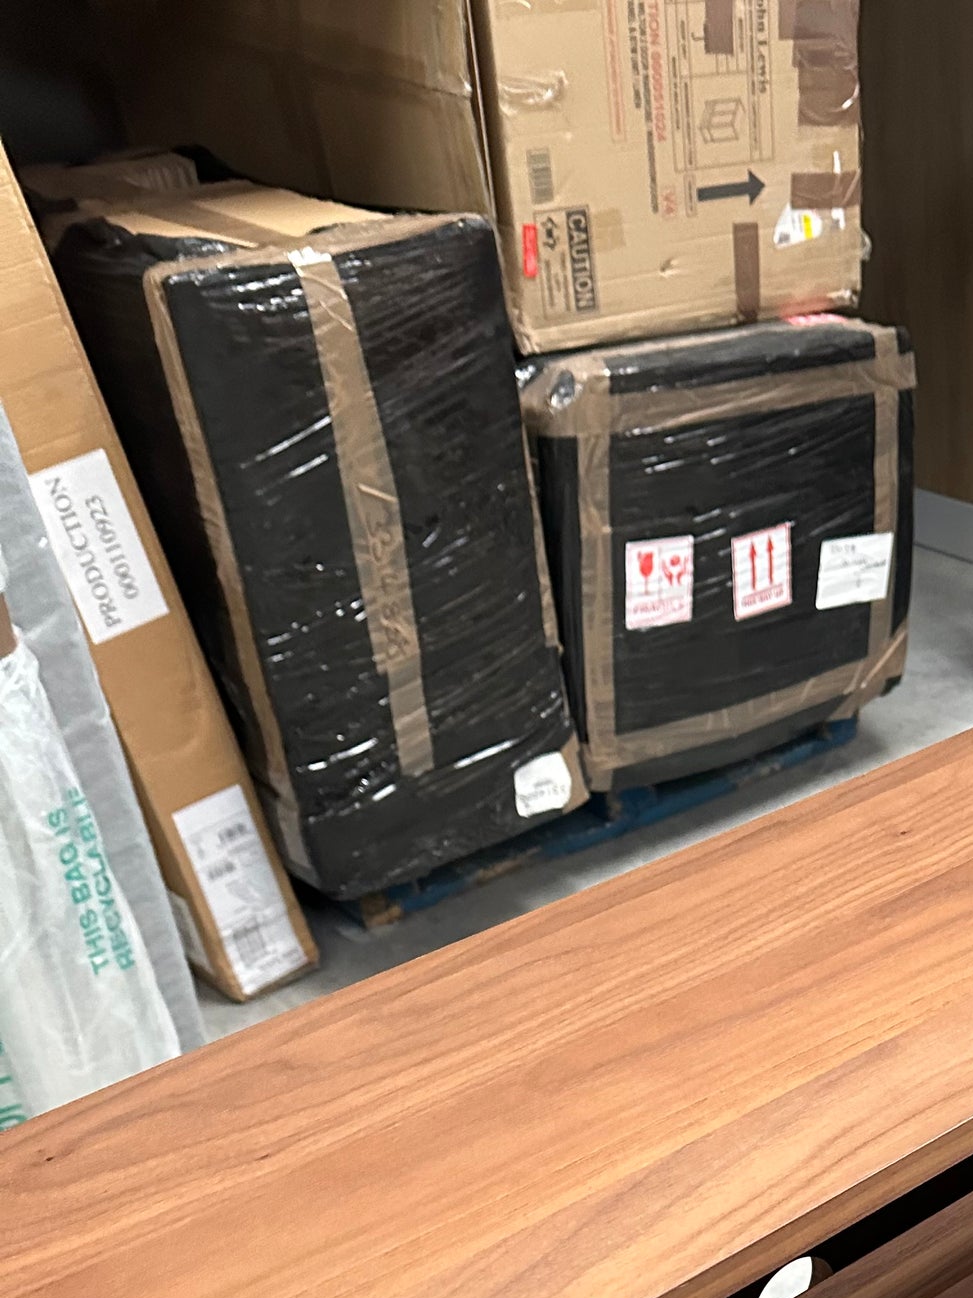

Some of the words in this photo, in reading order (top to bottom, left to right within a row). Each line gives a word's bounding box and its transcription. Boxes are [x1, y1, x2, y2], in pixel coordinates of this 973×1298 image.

[567, 214, 594, 309] CAUTION
[44, 477, 123, 628] PRODUCTION
[47, 807, 72, 838] IS
[77, 908, 109, 976] THIS
